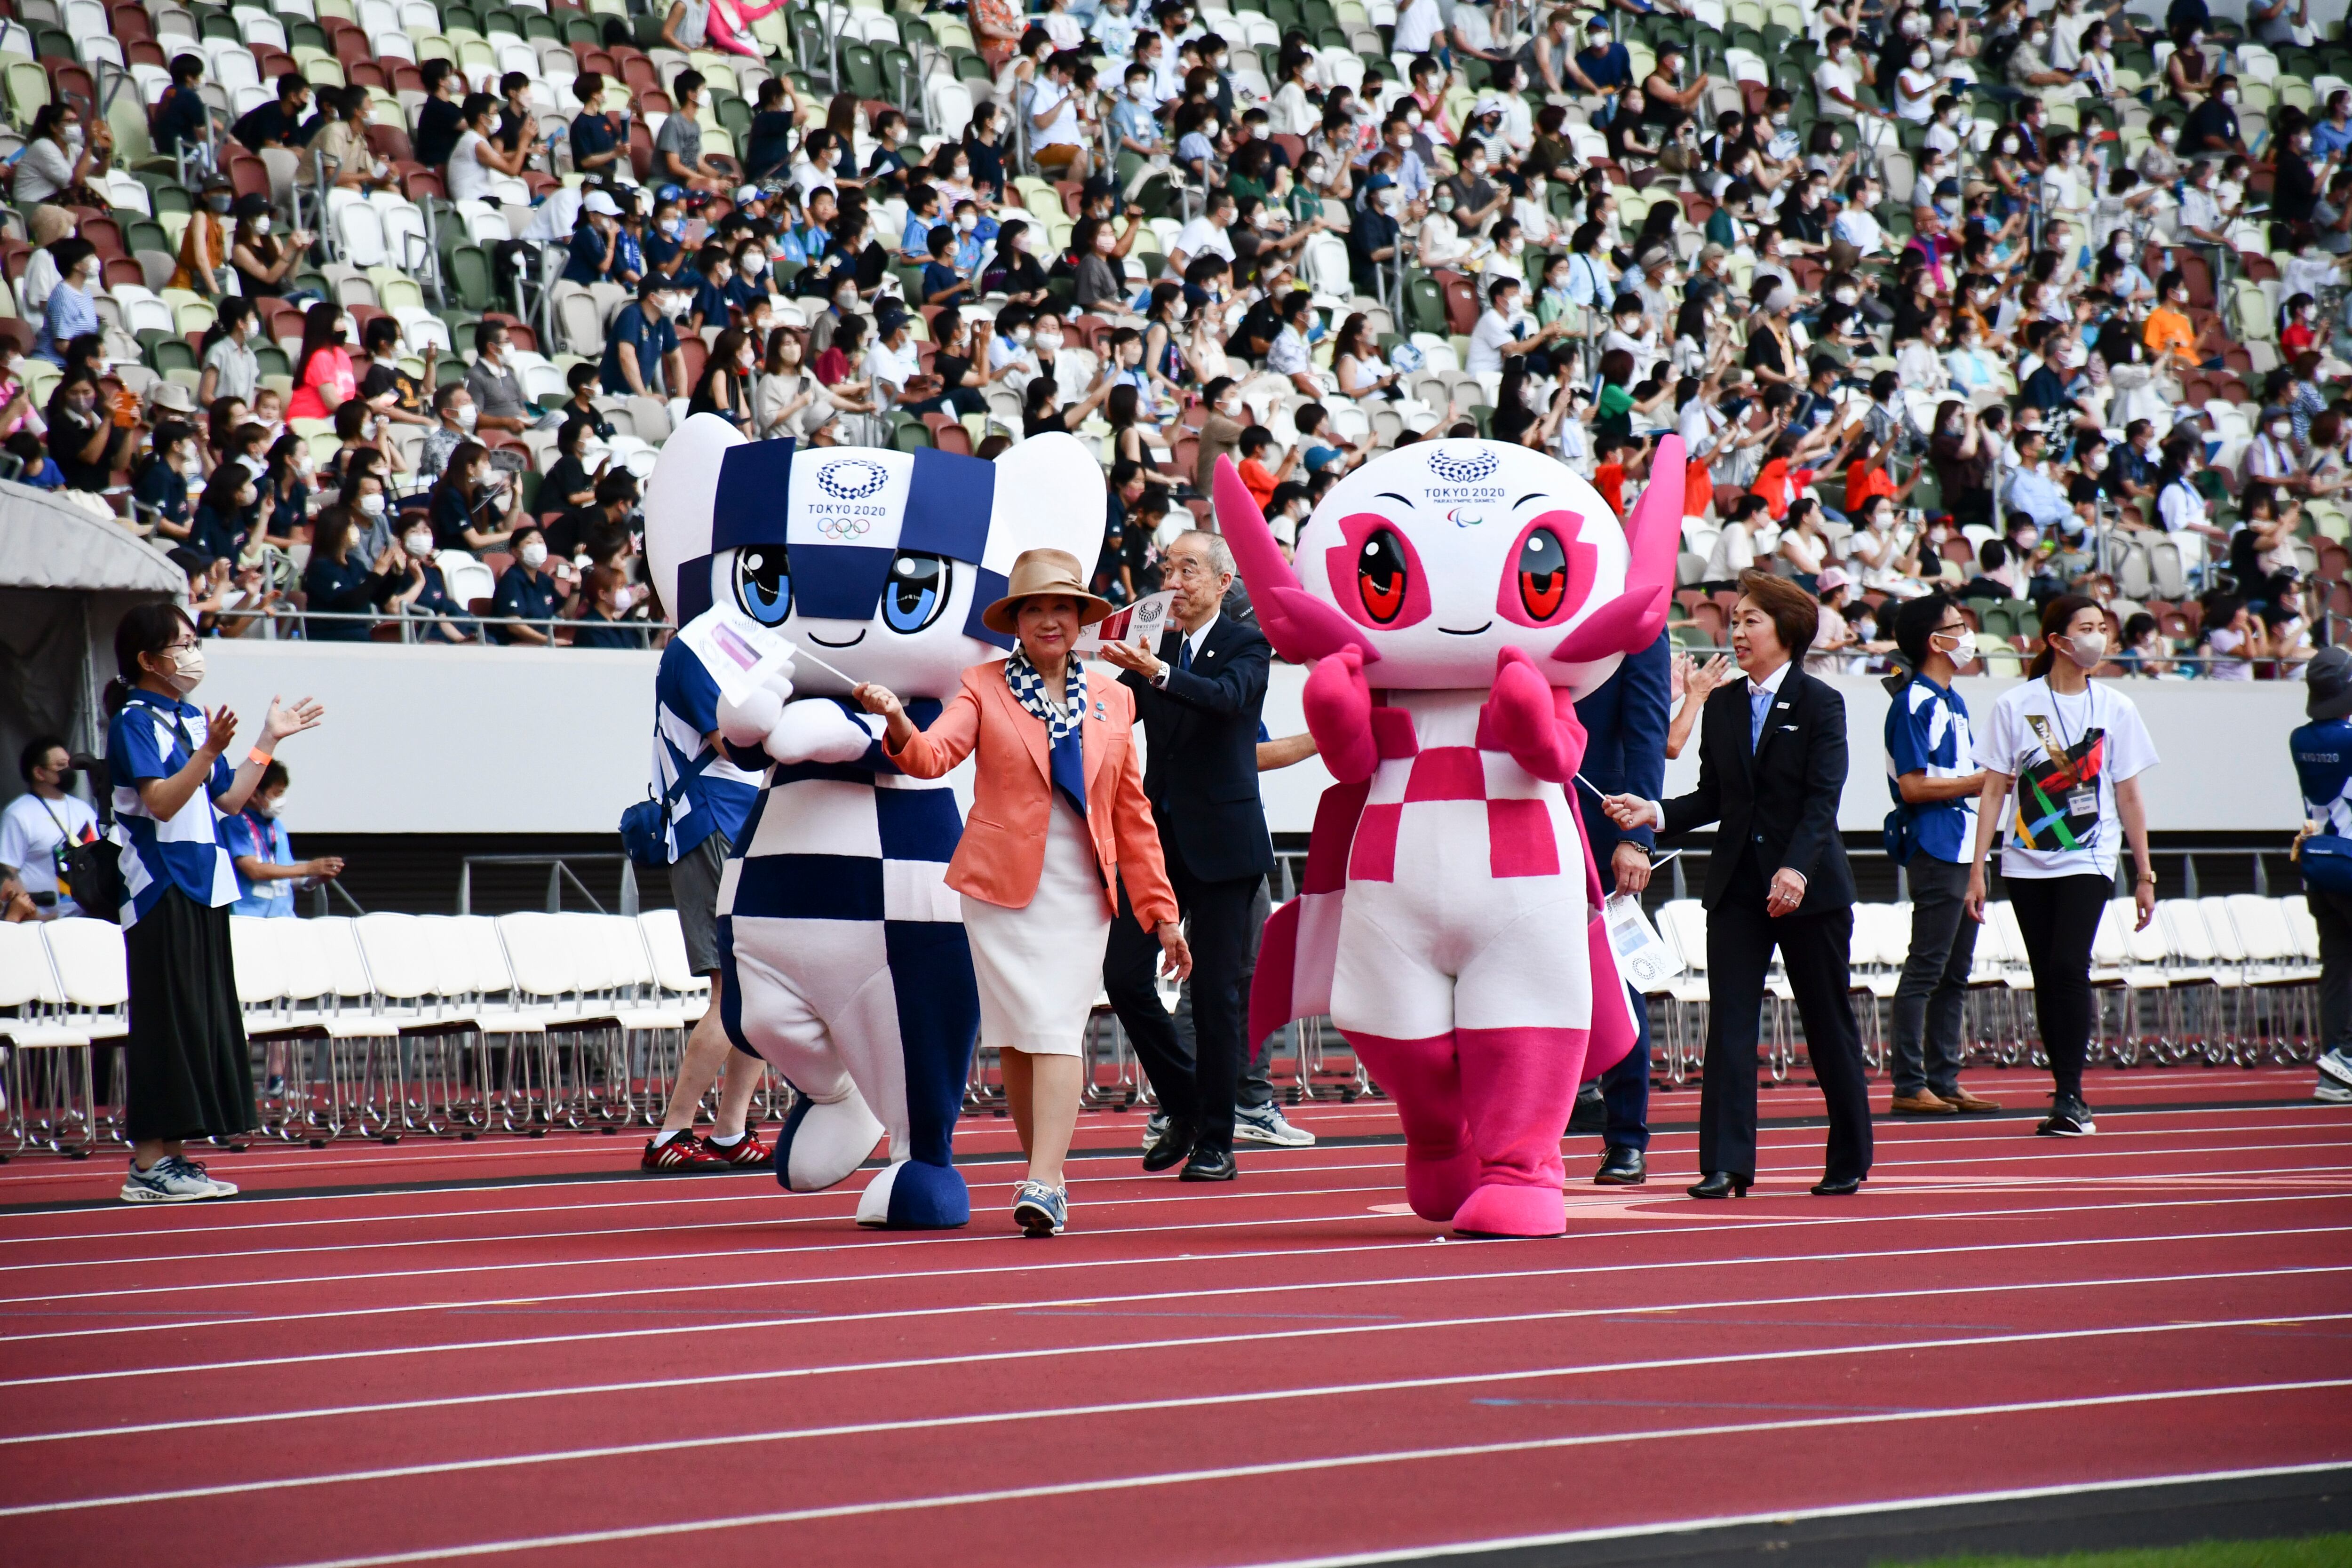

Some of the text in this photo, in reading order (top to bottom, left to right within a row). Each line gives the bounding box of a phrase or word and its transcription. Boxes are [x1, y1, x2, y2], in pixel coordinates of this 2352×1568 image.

[1424, 488, 1505, 498] TOKYO 2020
[808, 504, 886, 516] TOKYO 2020
[1239, 609, 1251, 618] TOKYO
